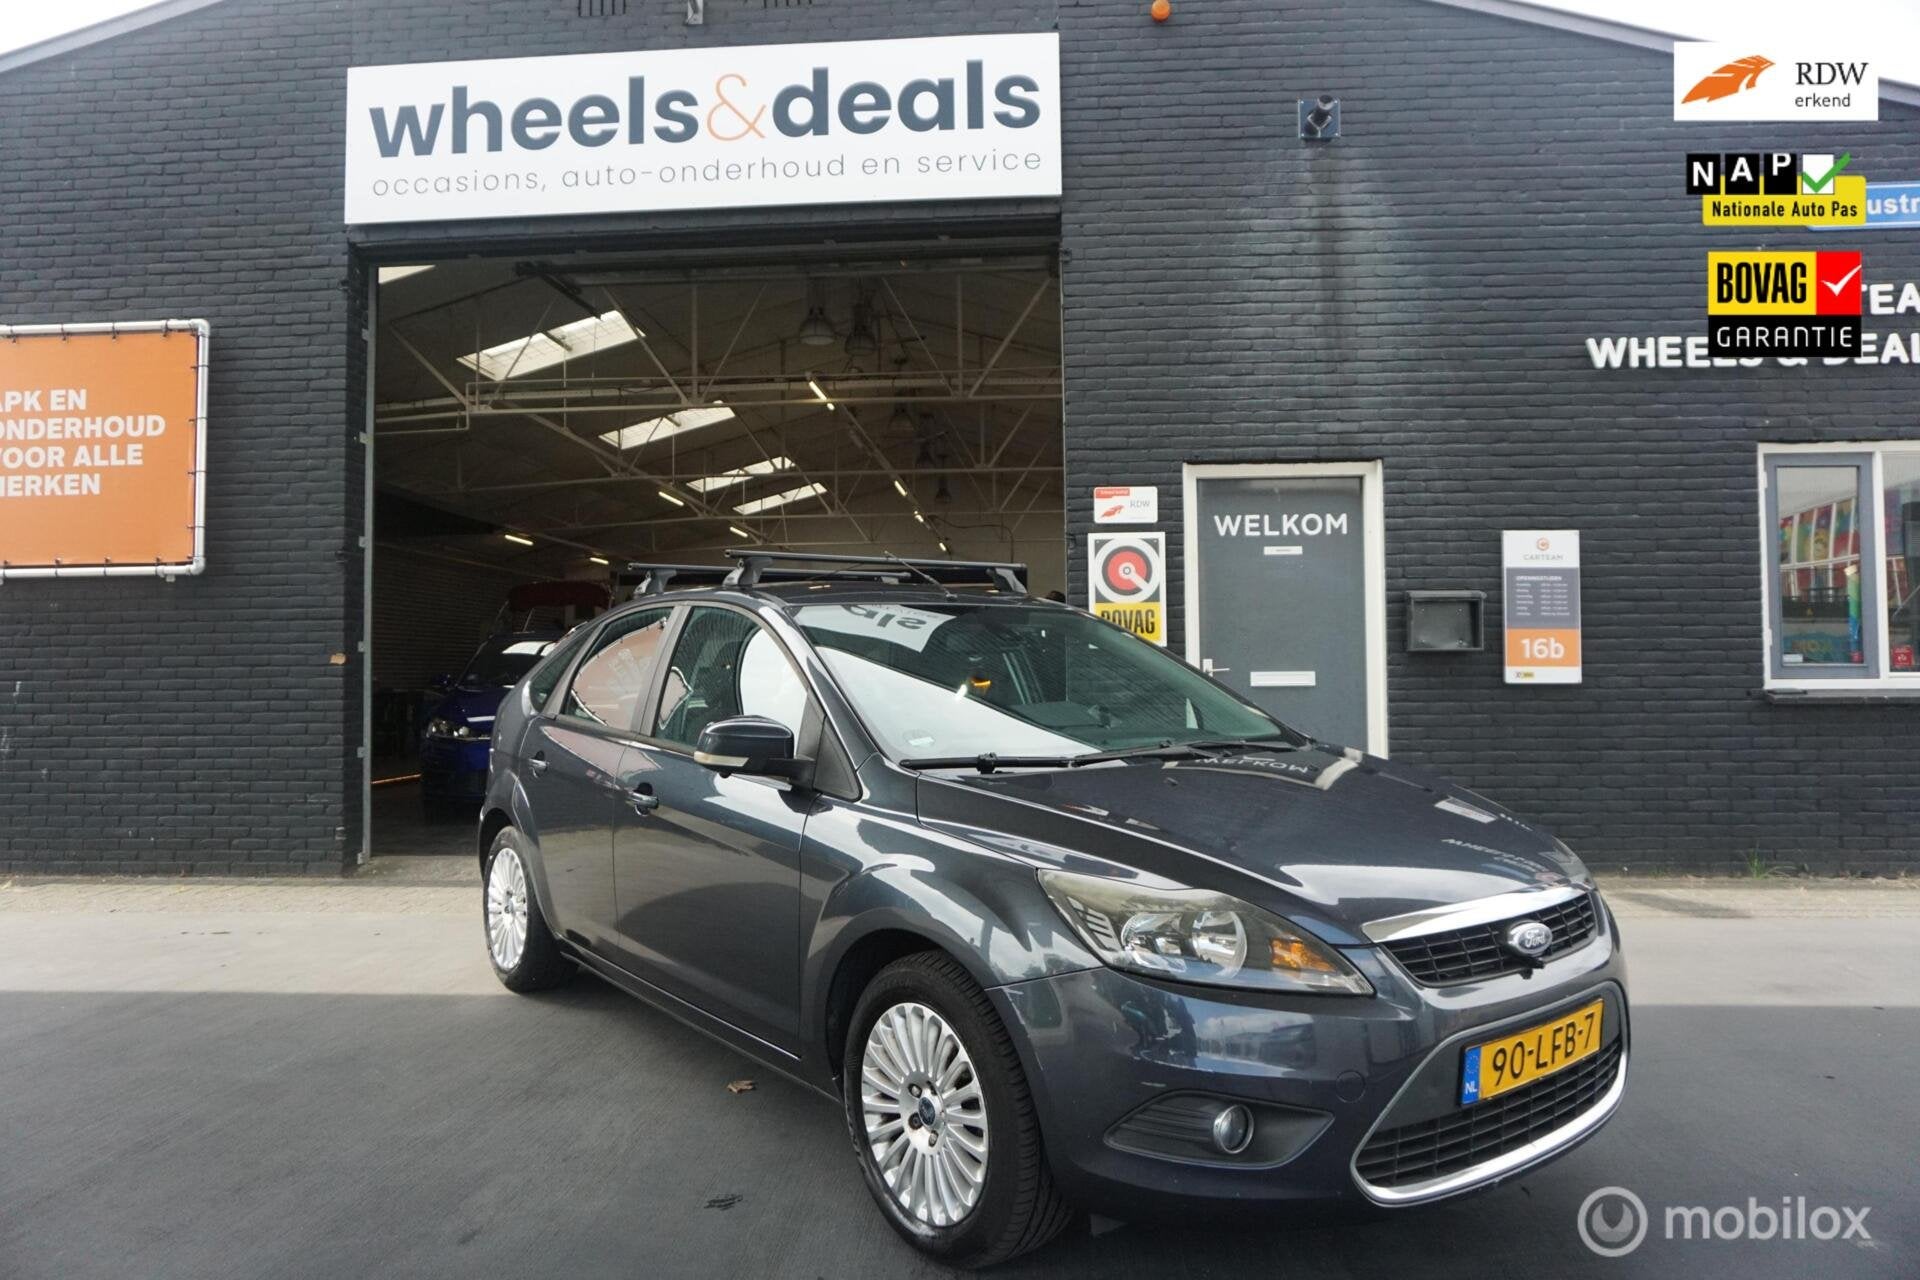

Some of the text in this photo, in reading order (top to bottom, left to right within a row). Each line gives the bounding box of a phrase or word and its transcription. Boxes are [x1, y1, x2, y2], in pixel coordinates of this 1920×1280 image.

[369, 59, 1041, 158] wheels&deals
[372, 147, 1042, 197] occasions, auto-onderhoud en service
[1585, 336, 1763, 368] WHEE
[0, 389, 87, 412] PK EN
[0, 415, 165, 440] NDERHOUD
[0, 444, 143, 469] OOR ALLE
[0, 473, 100, 497] ERKEN
[1214, 513, 1348, 537] WELKOM
[1521, 637, 1565, 659] 16b
[1524, 928, 1546, 947] Ford
[1492, 1012, 1595, 1086] 90-LFB-7
[1465, 1082, 1477, 1093] NL
